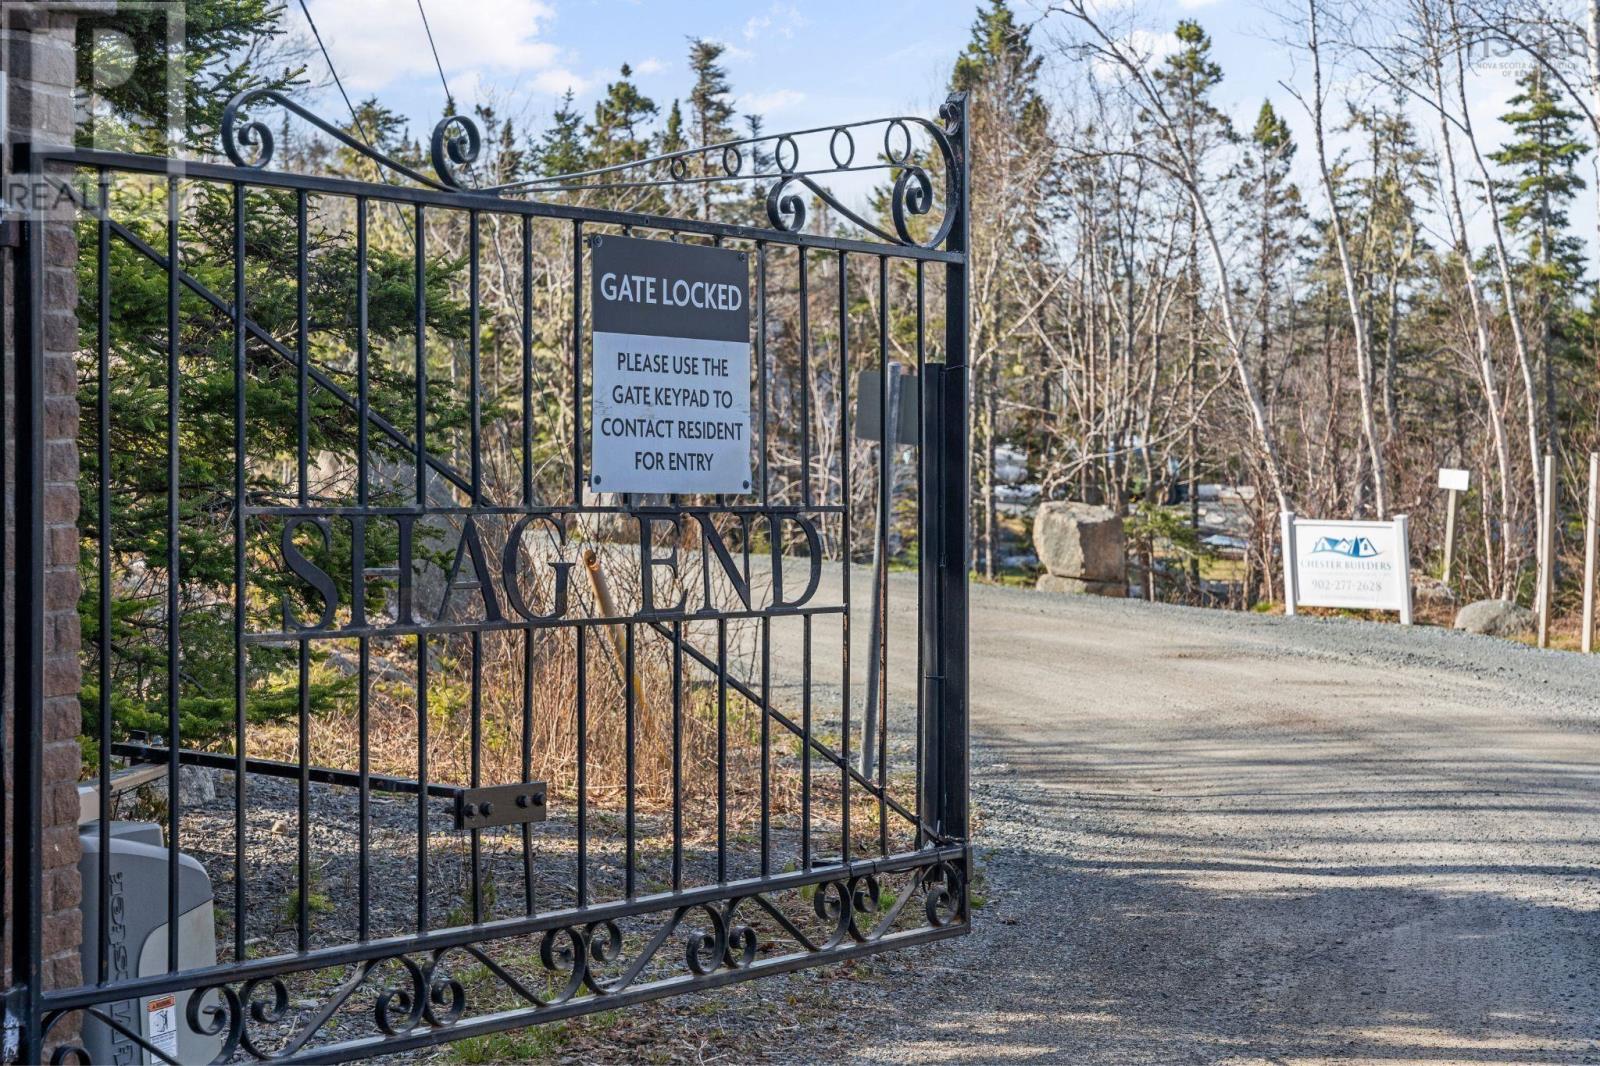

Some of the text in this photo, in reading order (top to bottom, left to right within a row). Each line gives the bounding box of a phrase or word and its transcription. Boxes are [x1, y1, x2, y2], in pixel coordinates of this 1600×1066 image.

[601, 273, 742, 311] GATE LOCKED
[617, 352, 729, 377] PLEASE USE THE
[612, 385, 733, 409] GATE KEYPAD TO
[601, 418, 743, 441] CONTACT RESIDENT
[635, 451, 714, 472] FOR ENTRY
[282, 511, 822, 630] SHAG END
[1300, 559, 1392, 571] CHESTER BUILDERS
